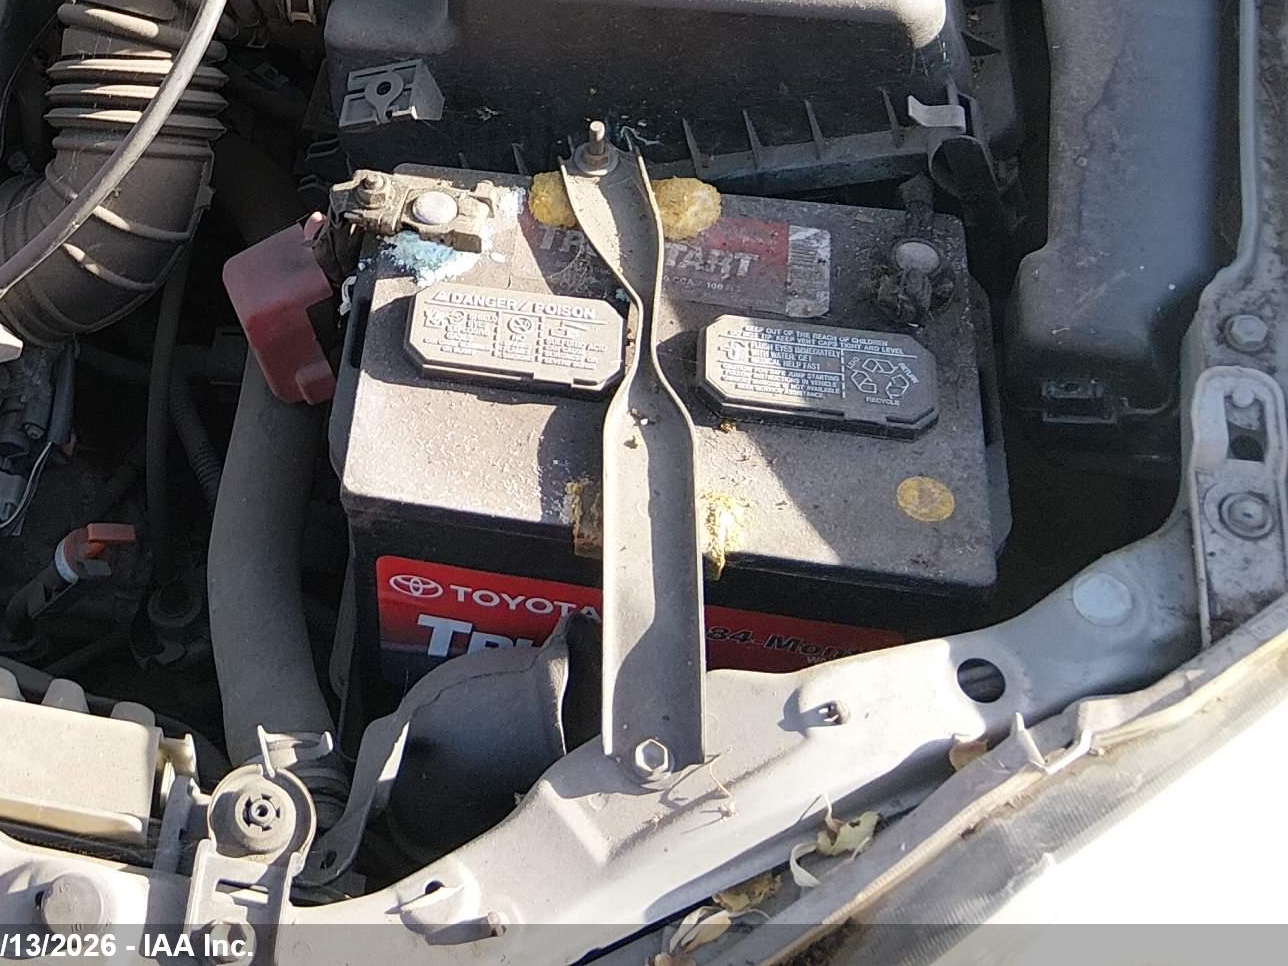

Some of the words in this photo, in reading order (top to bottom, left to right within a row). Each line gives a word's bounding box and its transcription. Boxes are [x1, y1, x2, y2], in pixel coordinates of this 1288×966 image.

[449, 293, 520, 311] DANGER
[533, 302, 596, 320] POISON
[796, 337, 817, 345] VENT
[839, 342, 861, 350] TIGHT
[881, 346, 904, 354] LEVEL
[813, 333, 837, 341] REACH
[851, 337, 888, 347] CHILDREN
[775, 344, 793, 353] EYES
[794, 346, 841, 358] IMMEDIATELY
[782, 360, 801, 368] HELP
[802, 362, 820, 370] FAST
[807, 373, 840, 382] STARTING
[810, 380, 837, 388] VEHICLE
[865, 396, 901, 407] RECYCLE
[449, 584, 602, 623] TOYOTA
